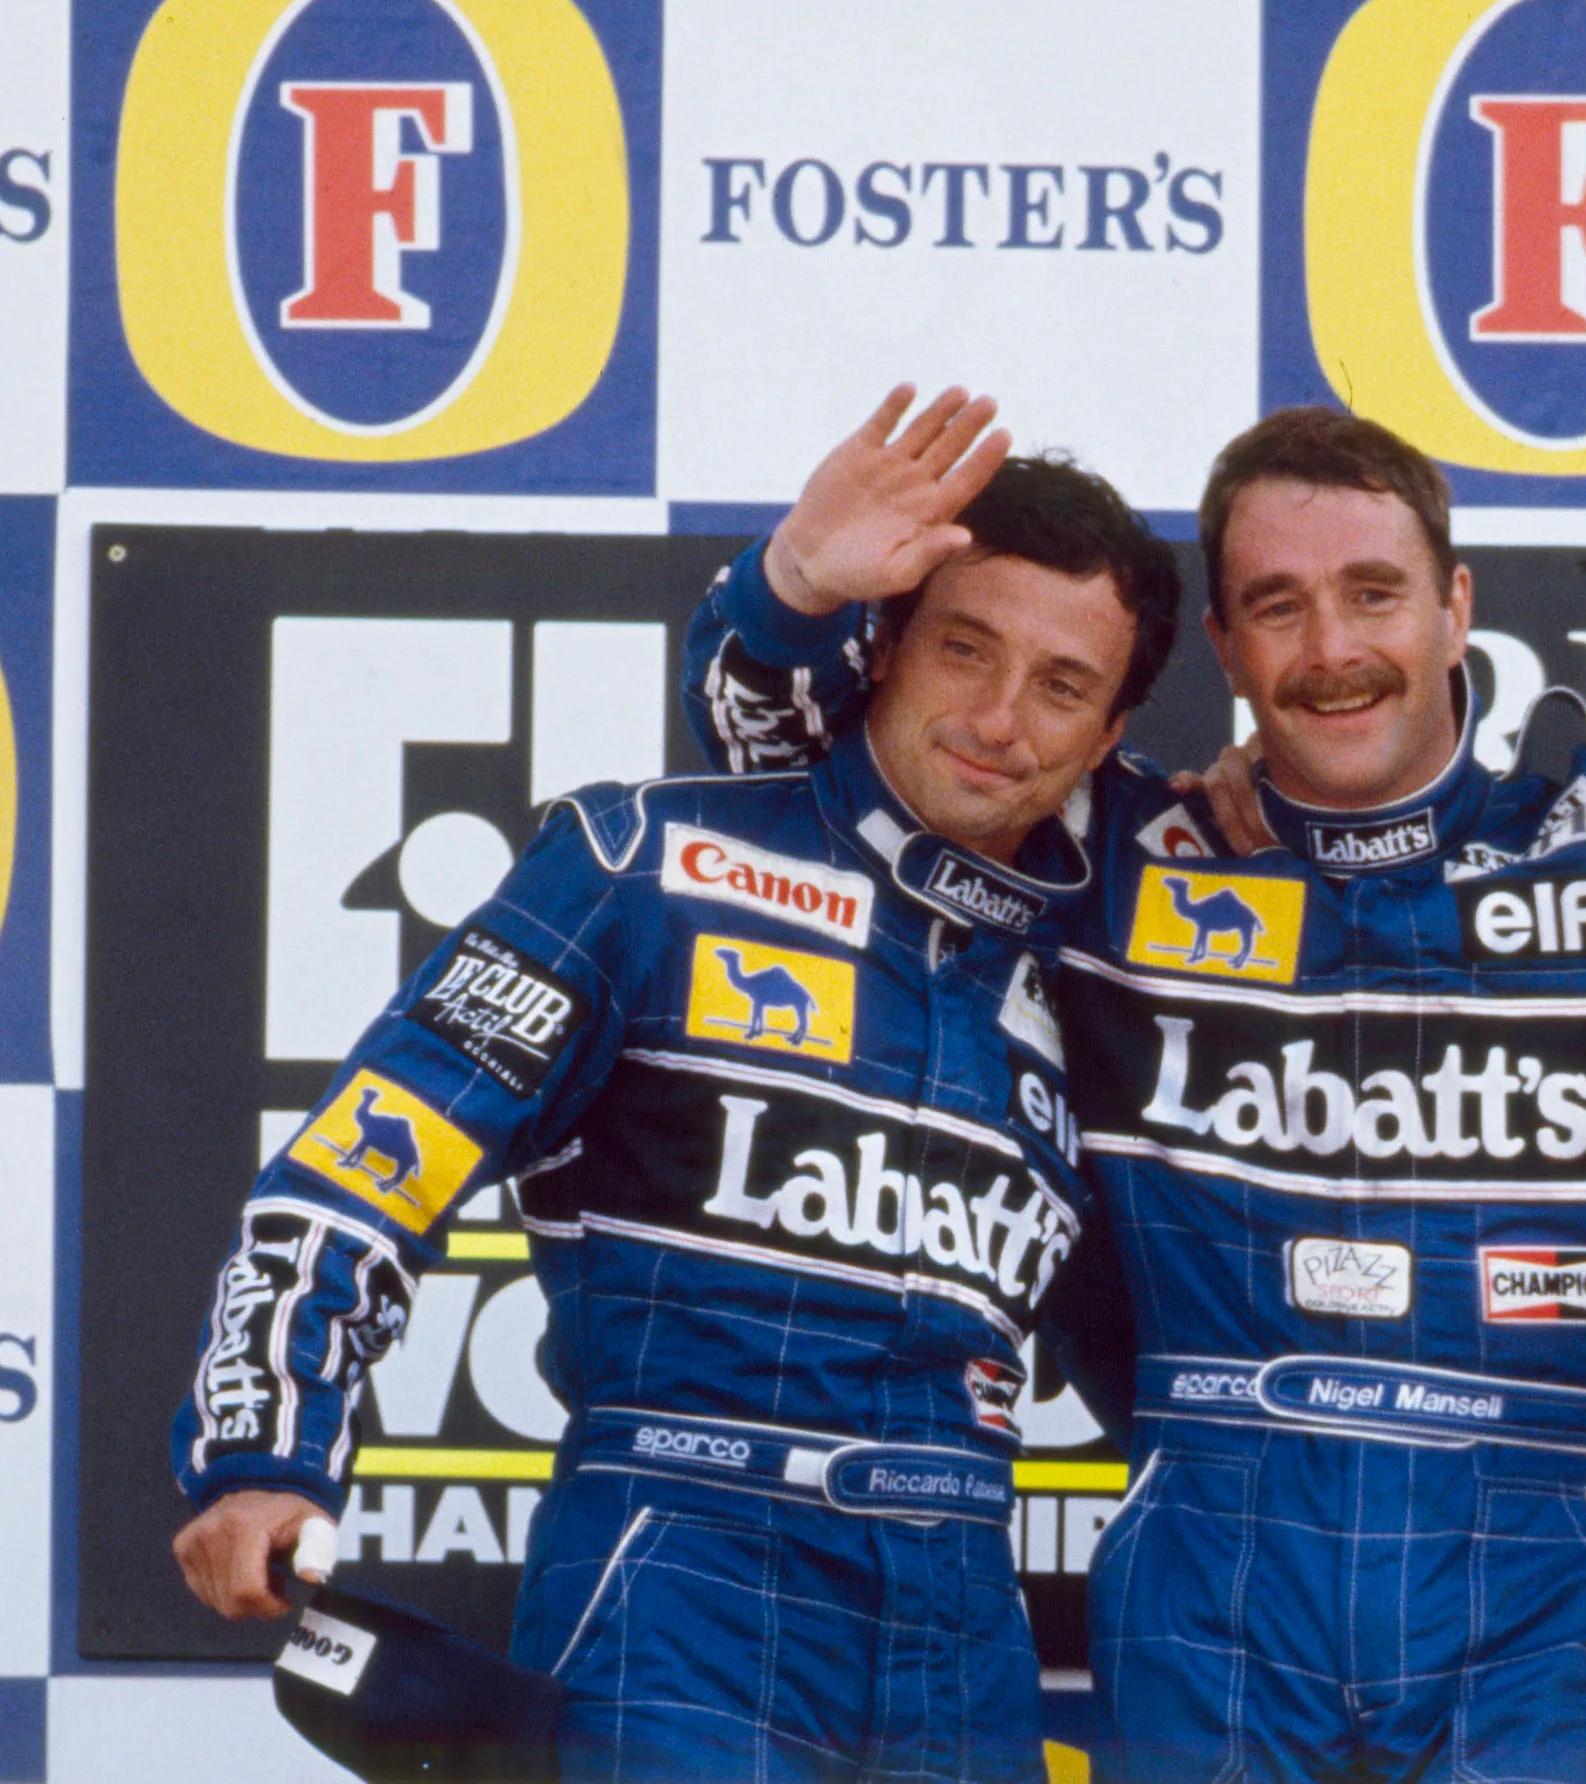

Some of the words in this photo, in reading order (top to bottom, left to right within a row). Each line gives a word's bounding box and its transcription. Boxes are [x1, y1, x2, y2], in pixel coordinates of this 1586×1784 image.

[701, 152, 1225, 254] FOSTER'S
[1313, 820, 1431, 864] Labatt's
[680, 841, 858, 929] Canon
[931, 859, 1033, 928] Labatt's
[468, 964, 572, 1044] CLUB
[703, 1094, 1070, 1304] Labatt's
[1308, 1378, 1383, 1409] Nigel
[1394, 1381, 1504, 1418] Mansell
[632, 1425, 749, 1467] sparco
[868, 1467, 961, 1496] Riccardo
